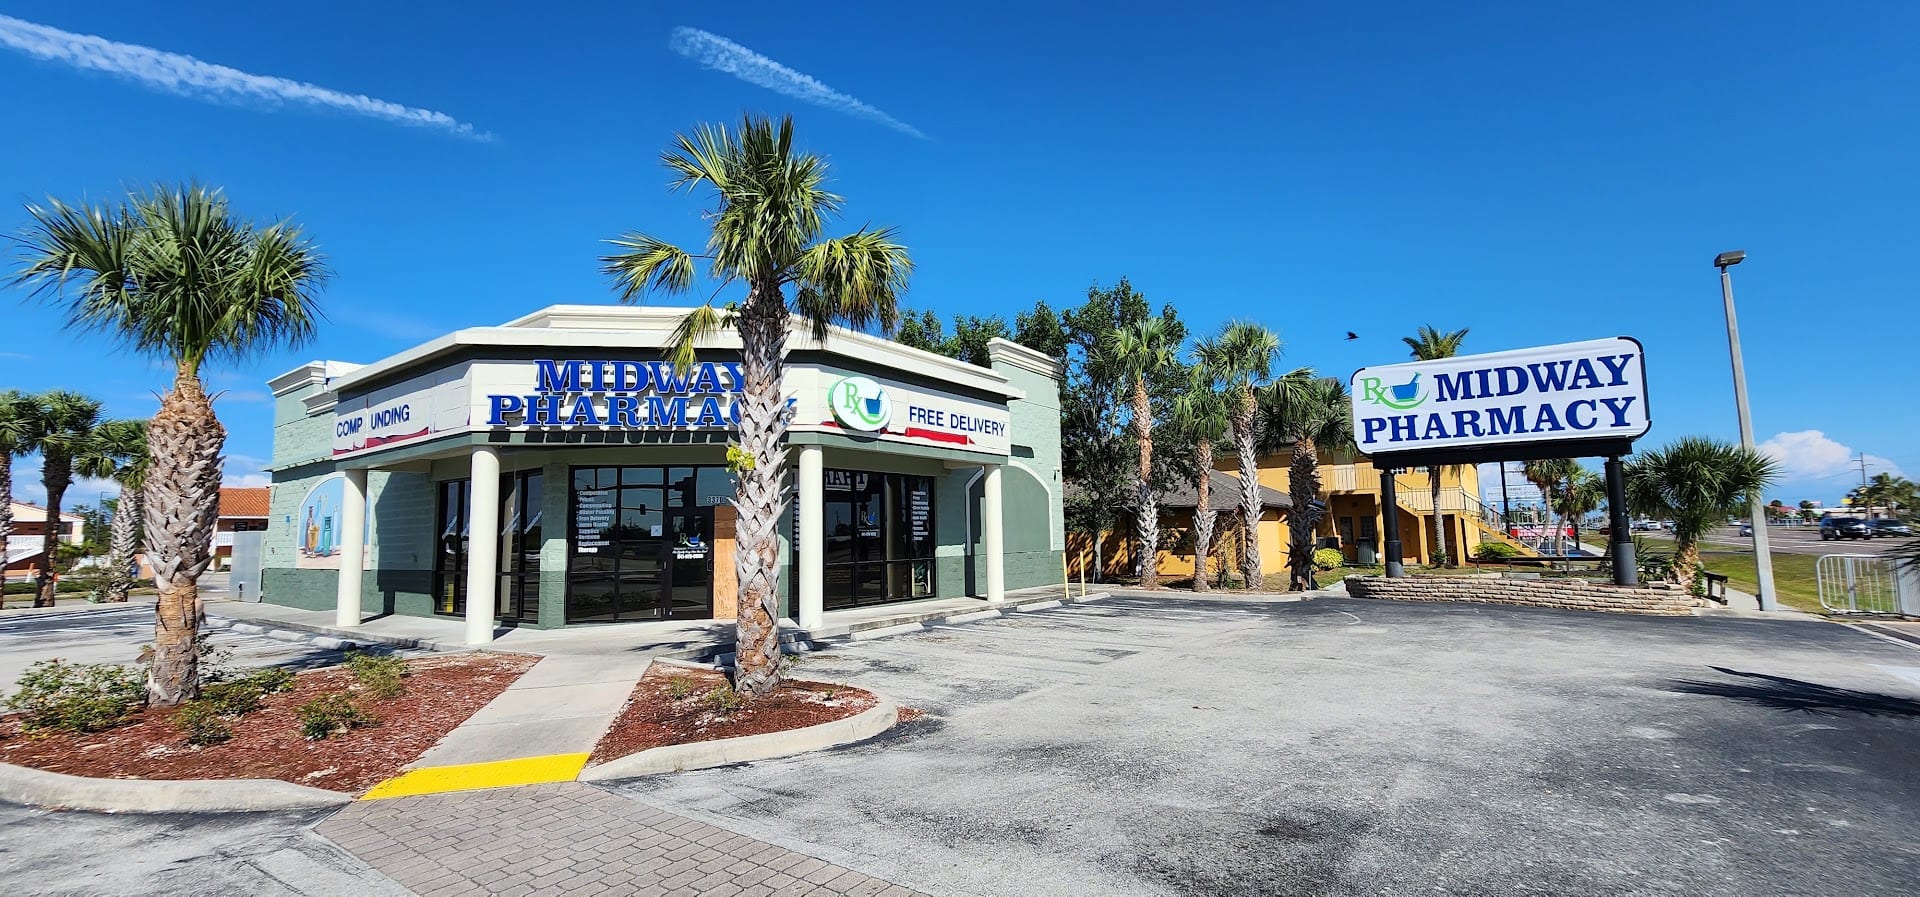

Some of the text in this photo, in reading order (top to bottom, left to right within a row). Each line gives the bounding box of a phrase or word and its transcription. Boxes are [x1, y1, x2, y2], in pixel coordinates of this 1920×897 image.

[1433, 353, 1635, 403] MIDWAY
[486, 394, 798, 427] PHARMA
[909, 405, 1005, 437] FREE DELIVERY
[1361, 396, 1637, 444] PHARMACY
